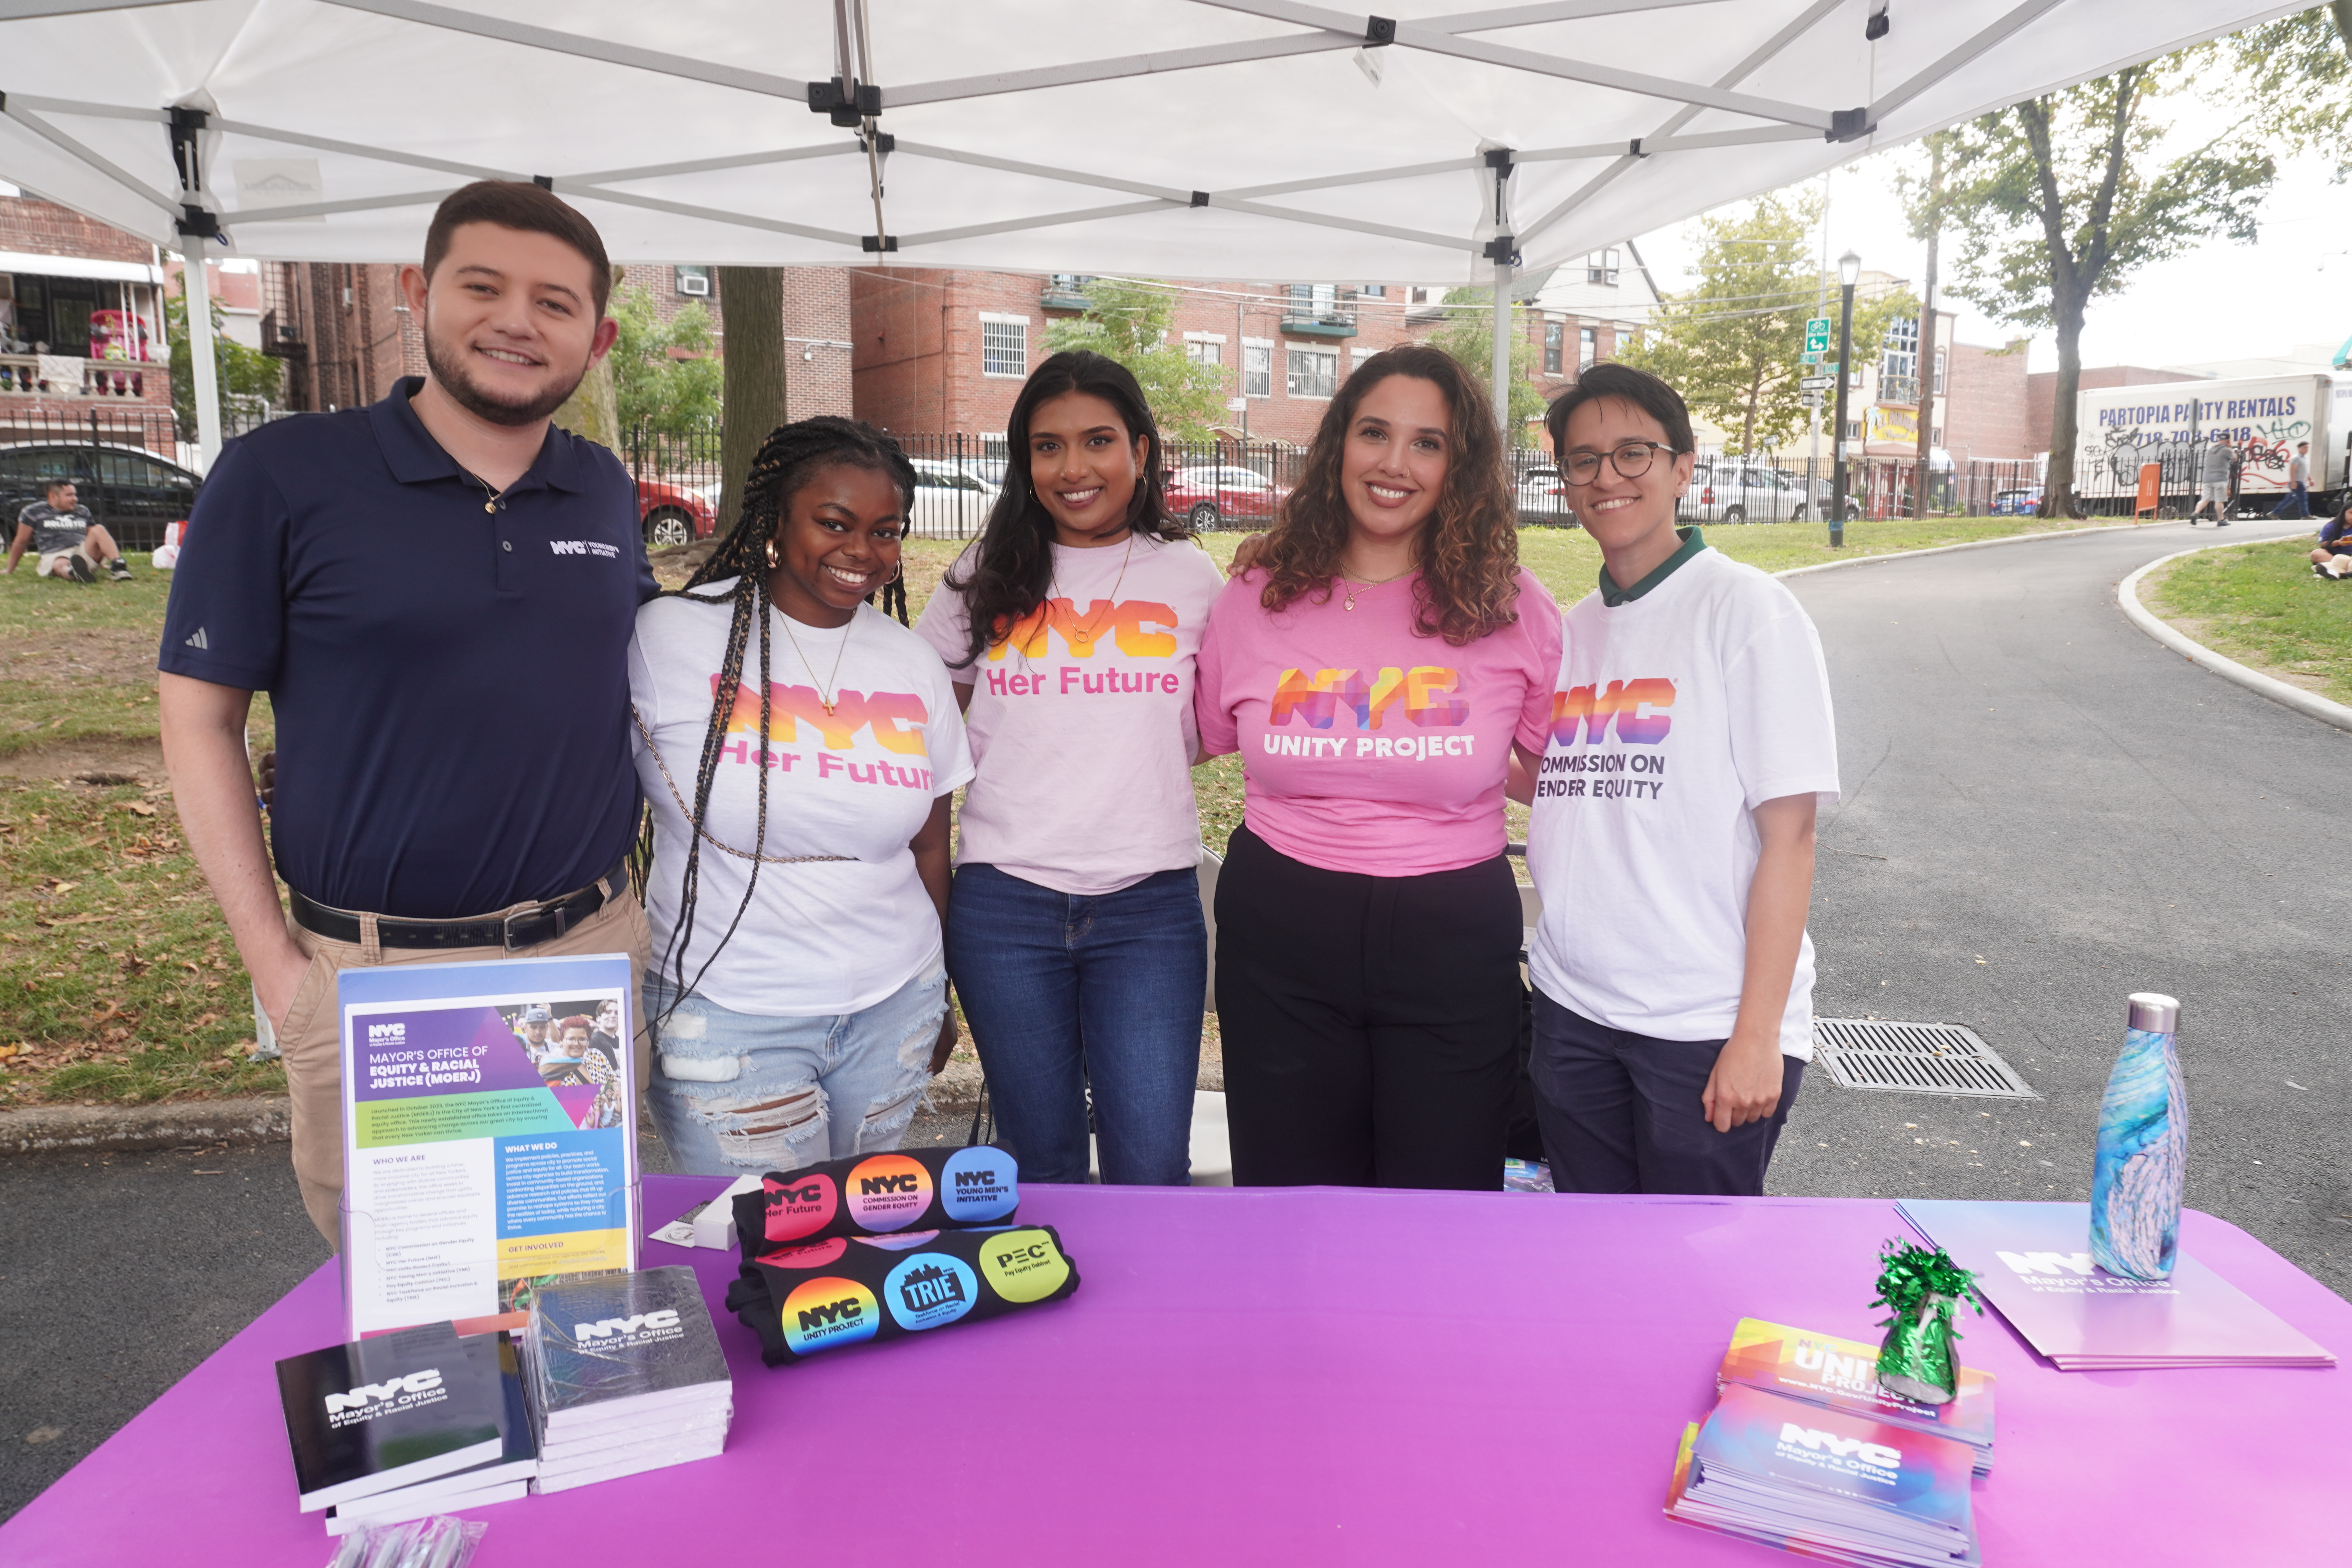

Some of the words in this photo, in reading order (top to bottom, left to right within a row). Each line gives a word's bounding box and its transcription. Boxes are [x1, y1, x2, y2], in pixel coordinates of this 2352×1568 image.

[2099, 405, 2170, 426] PARTOPIA
[2175, 401, 2223, 422] PARTY
[2227, 396, 2296, 419] RENTALS
[550, 541, 586, 555] NYC
[592, 549, 616, 558] INITIATIVE
[987, 597, 1178, 661] NYC
[987, 668, 1046, 695] Her
[1060, 666, 1179, 694] Future
[1269, 666, 1470, 730] NYC
[710, 673, 929, 757] NYC
[1545, 677, 1677, 747] NYC
[718, 738, 800, 772] Her
[1264, 734, 1348, 757] UNITY
[1356, 735, 1475, 761] PROJECT
[1541, 753, 1626, 775] OMMISSION
[1630, 754, 1664, 774] ON
[1537, 779, 1585, 797] ENDER
[1592, 779, 1663, 800] EQUITY
[368, 1023, 405, 1038] NYC
[370, 1050, 424, 1064] MAYOR'S
[428, 1047, 468, 1059] OFFICE
[472, 1045, 488, 1056] OF
[370, 1063, 416, 1076] EQUITY
[419, 1063, 430, 1072] &
[432, 1058, 479, 1072] RACIAL
[370, 1075, 423, 1089] JUSTICE
[425, 1069, 481, 1087] (MOERJ)
[505, 1143, 529, 1153] WHAT
[860, 1173, 917, 1195] NYC
[955, 1170, 995, 1187] NYC
[765, 1184, 821, 1207] NYC
[863, 1195, 906, 1204] COMMISSION
[893, 1201, 917, 1210] EQUITY
[765, 1209, 784, 1219] Her
[786, 1205, 822, 1214] Future
[525, 1241, 564, 1251] INVOLVED
[996, 1244, 1045, 1269] PEC
[1015, 1265, 1031, 1274] Equity
[1031, 1259, 1051, 1268] Cabinet
[1995, 1251, 2095, 1275] NY
[904, 1275, 956, 1308] TRIE
[2019, 1276, 2105, 1287] Mayor's
[2105, 1277, 2171, 1287] Office
[797, 1297, 862, 1332] NYC
[915, 1308, 938, 1319] Taskforce
[945, 1301, 960, 1310] Racial
[915, 1314, 937, 1324] Inclusion
[942, 1308, 956, 1317] Equity
[575, 1309, 680, 1341] NYC
[803, 1328, 828, 1341] UNITY
[828, 1318, 864, 1335] PROJECT
[577, 1334, 636, 1349] Mayor's
[639, 1327, 682, 1338] Office
[626, 1338, 653, 1346] Racial
[655, 1333, 684, 1342] Justice
[1799, 1338, 1837, 1353] NYC
[1794, 1346, 1877, 1381] UNI
[325, 1369, 443, 1414] NYC
[1779, 1377, 1936, 1417] www.NYC.Gov/UnityProject
[1821, 1373, 1916, 1404] PROJE
[329, 1401, 394, 1423] Mayor's
[398, 1388, 446, 1405] Office
[343, 1413, 373, 1426] Equity
[384, 1403, 413, 1415] Racial
[415, 1394, 448, 1407] Justice
[1780, 1423, 1902, 1469] NYC
[1777, 1441, 1842, 1465] Mayor's
[1846, 1459, 1898, 1479] Office
[1787, 1454, 1817, 1466] Equity
[1828, 1464, 1858, 1477] Racial
[1859, 1472, 1896, 1486] Justice
